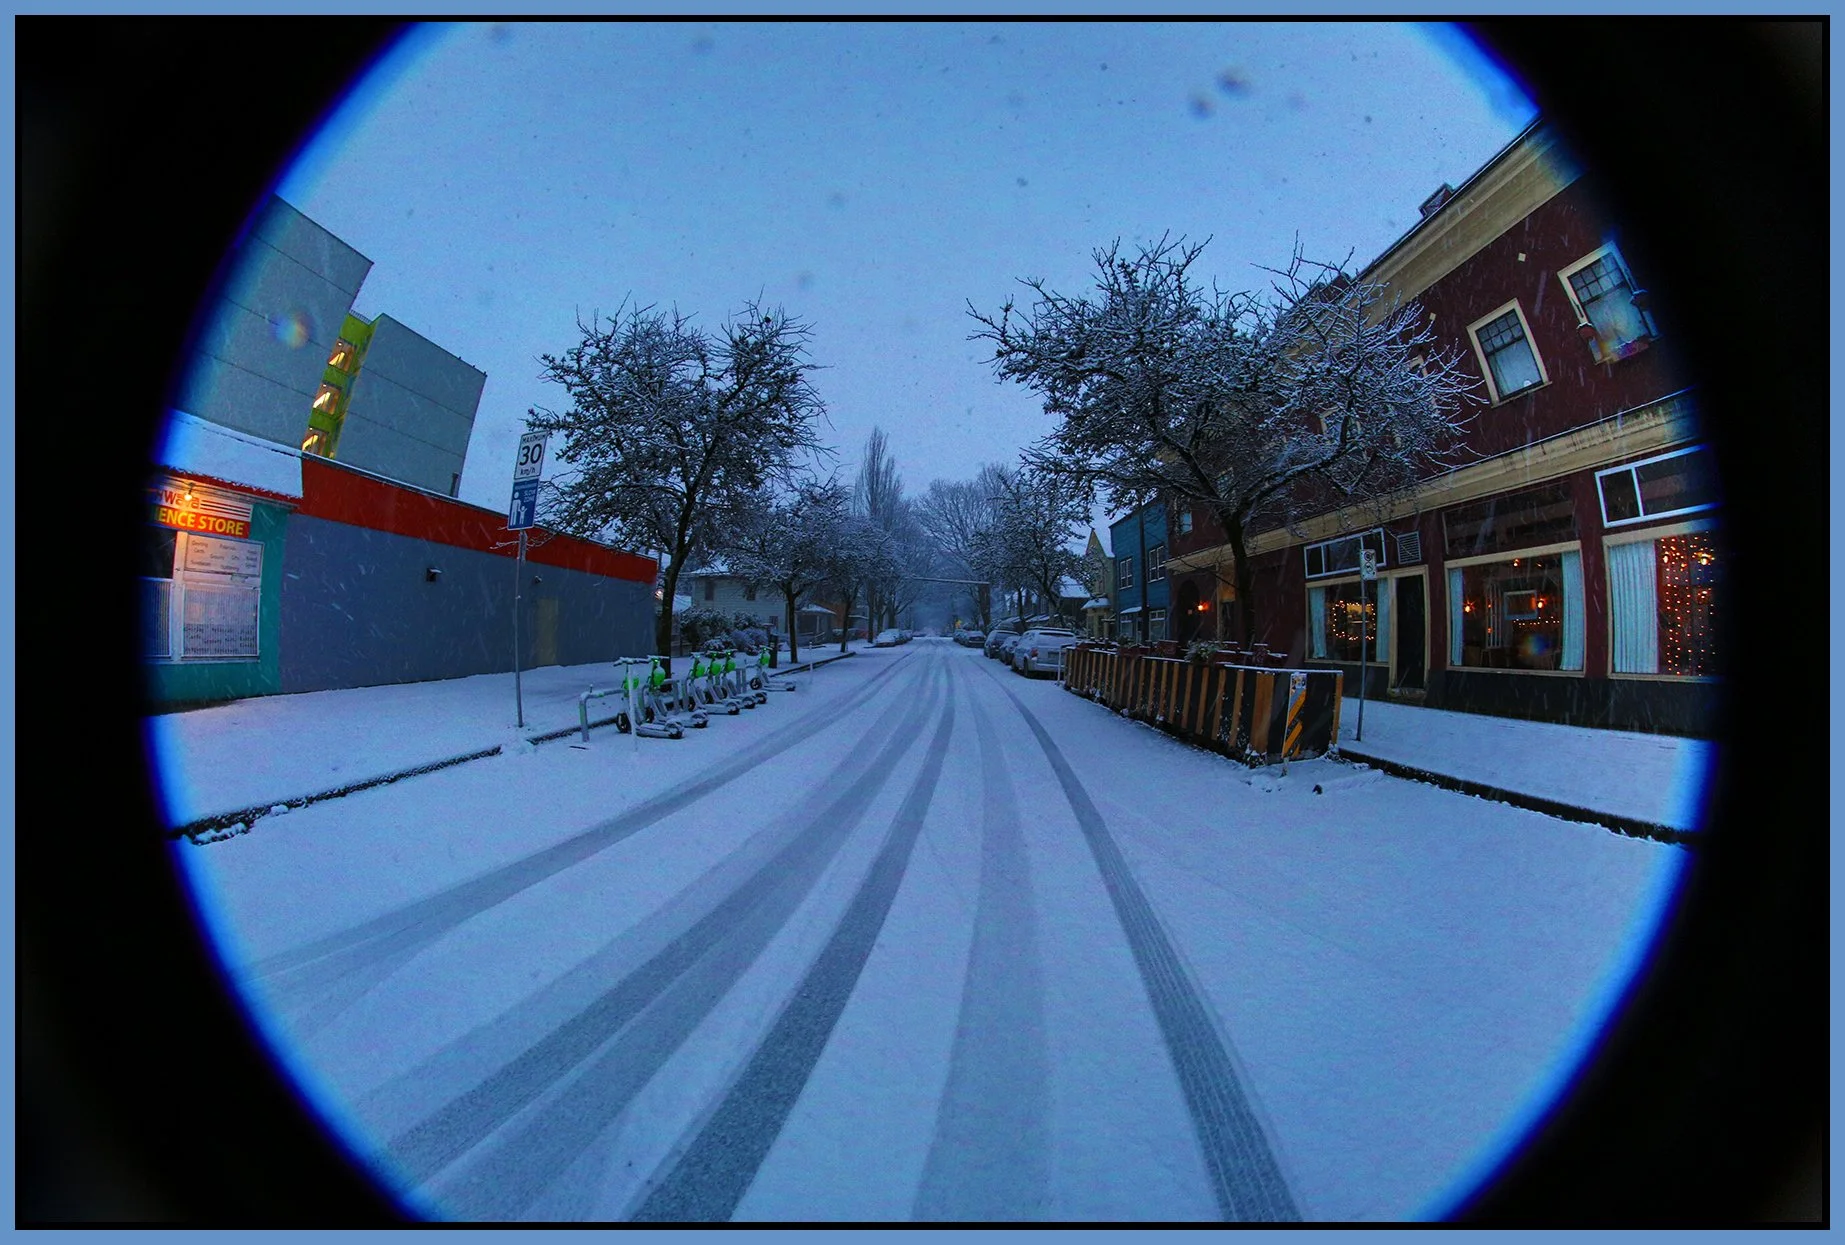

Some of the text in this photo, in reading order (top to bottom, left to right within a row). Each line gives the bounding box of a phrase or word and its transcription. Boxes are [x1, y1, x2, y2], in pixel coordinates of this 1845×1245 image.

[519, 443, 542, 466] 30
[519, 467, 536, 476] km/h
[197, 515, 245, 536] STORE
